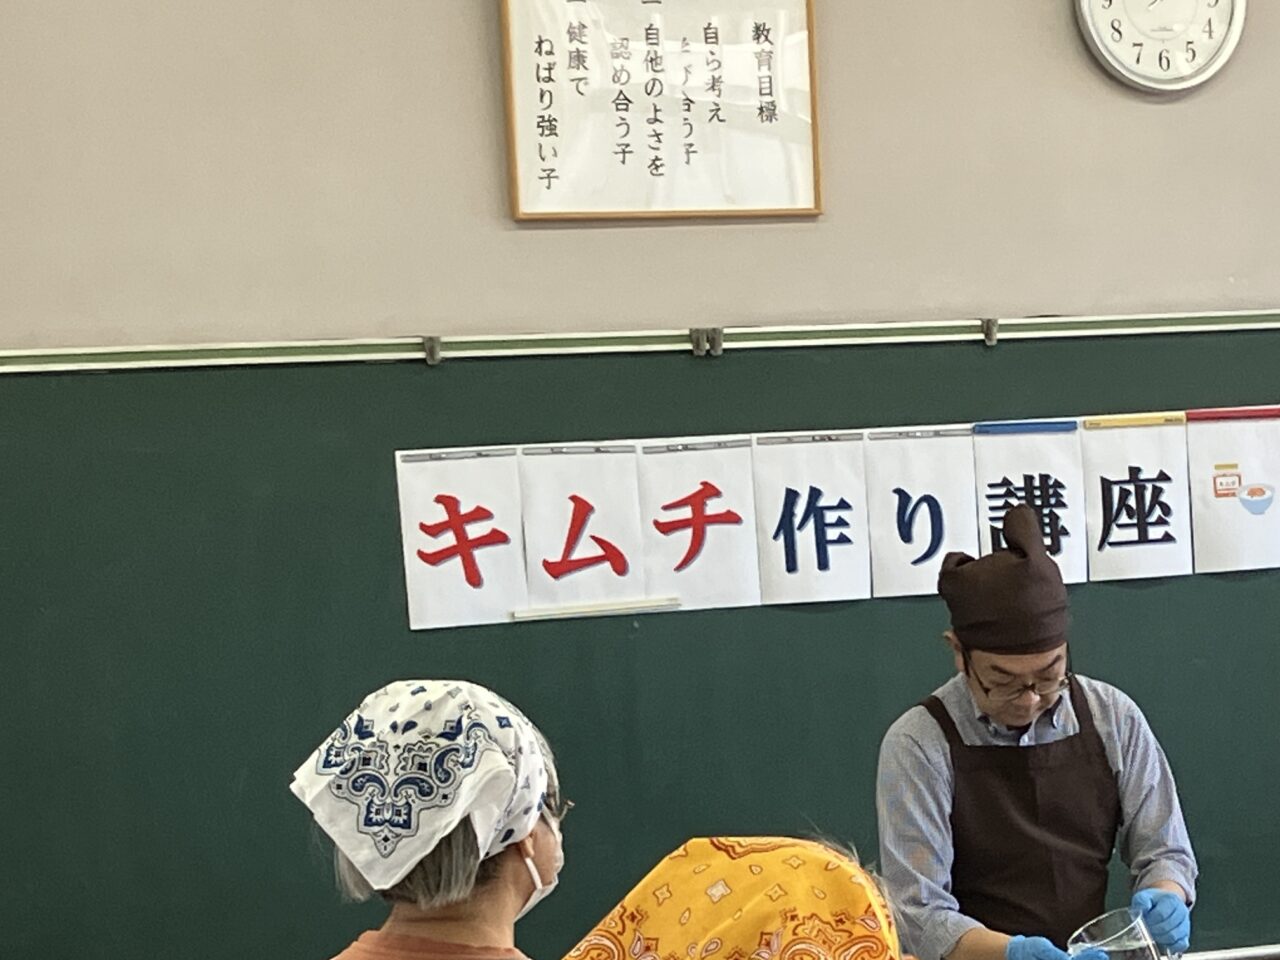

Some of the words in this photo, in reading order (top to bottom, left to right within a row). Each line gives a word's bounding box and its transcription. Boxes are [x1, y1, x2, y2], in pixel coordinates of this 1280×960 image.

[566, 21, 591, 97] 健康で
[702, 22, 727, 124] 自ら考え
[751, 22, 779, 124] 教育目標
[1110, 18, 1123, 43] 8
[1132, 42, 1144, 65] 7
[1158, 48, 1171, 72] 6
[1185, 40, 1197, 63] 5
[1202, 17, 1214, 40] 4
[533, 35, 560, 190] ねばり強い子
[610, 36, 635, 166] 認め合う子
[643, 22, 666, 177] 自他のよさを
[416, 465, 1177, 588] キムチ作り講座
